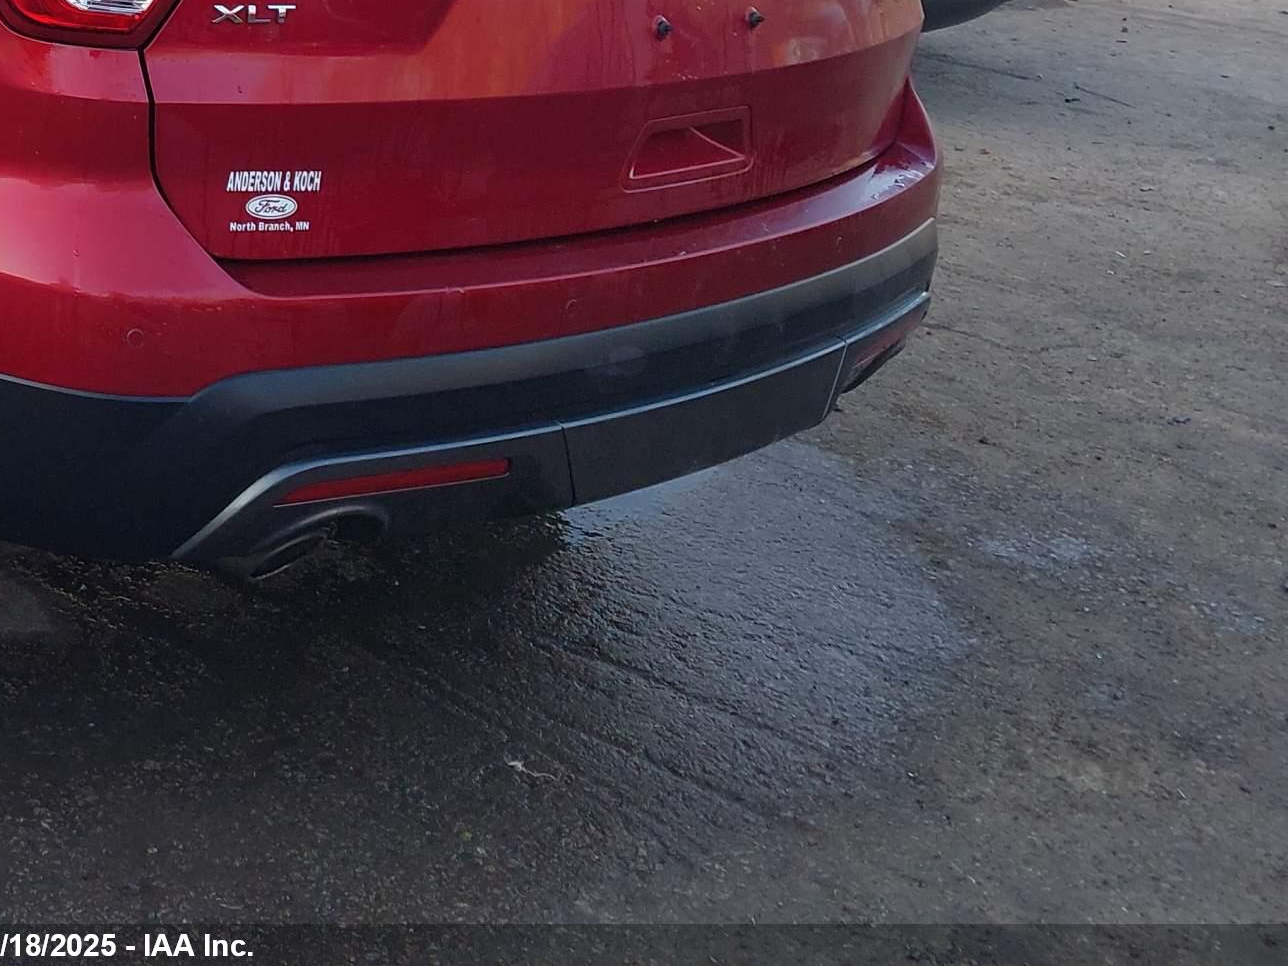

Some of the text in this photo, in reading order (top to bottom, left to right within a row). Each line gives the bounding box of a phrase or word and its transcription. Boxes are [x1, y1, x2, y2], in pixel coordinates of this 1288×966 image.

[212, 4, 297, 24] XLT
[226, 170, 322, 192] ANDERSON & KOCH
[254, 199, 289, 214] Ford
[229, 221, 310, 233] North Branch, MN
